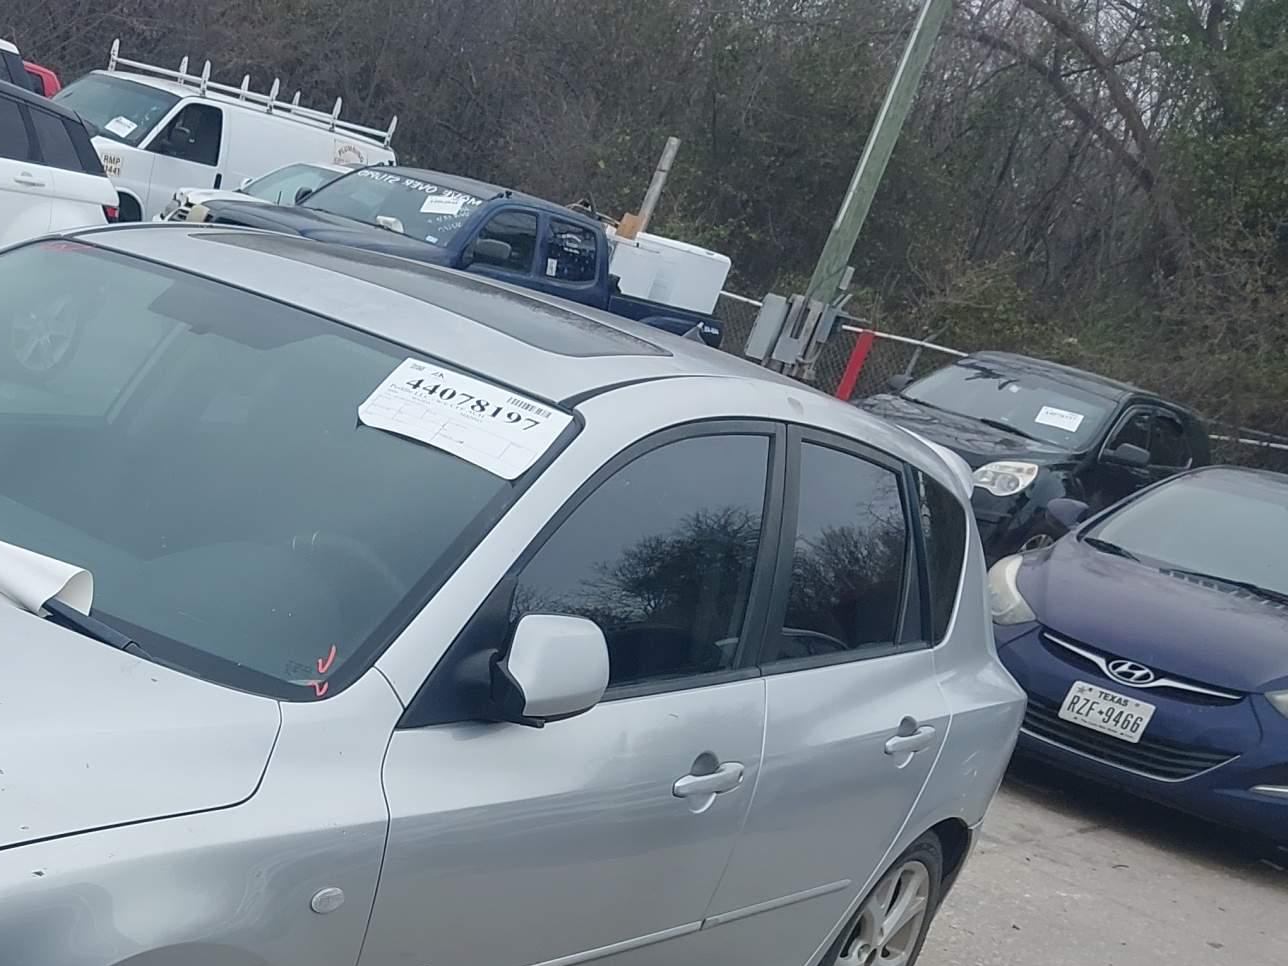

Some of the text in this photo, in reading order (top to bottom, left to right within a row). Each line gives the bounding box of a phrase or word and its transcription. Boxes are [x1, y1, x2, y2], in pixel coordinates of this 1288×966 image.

[103, 154, 121, 165] RMP
[406, 378, 540, 432] 44078197
[1098, 691, 1129, 707] TEXAS
